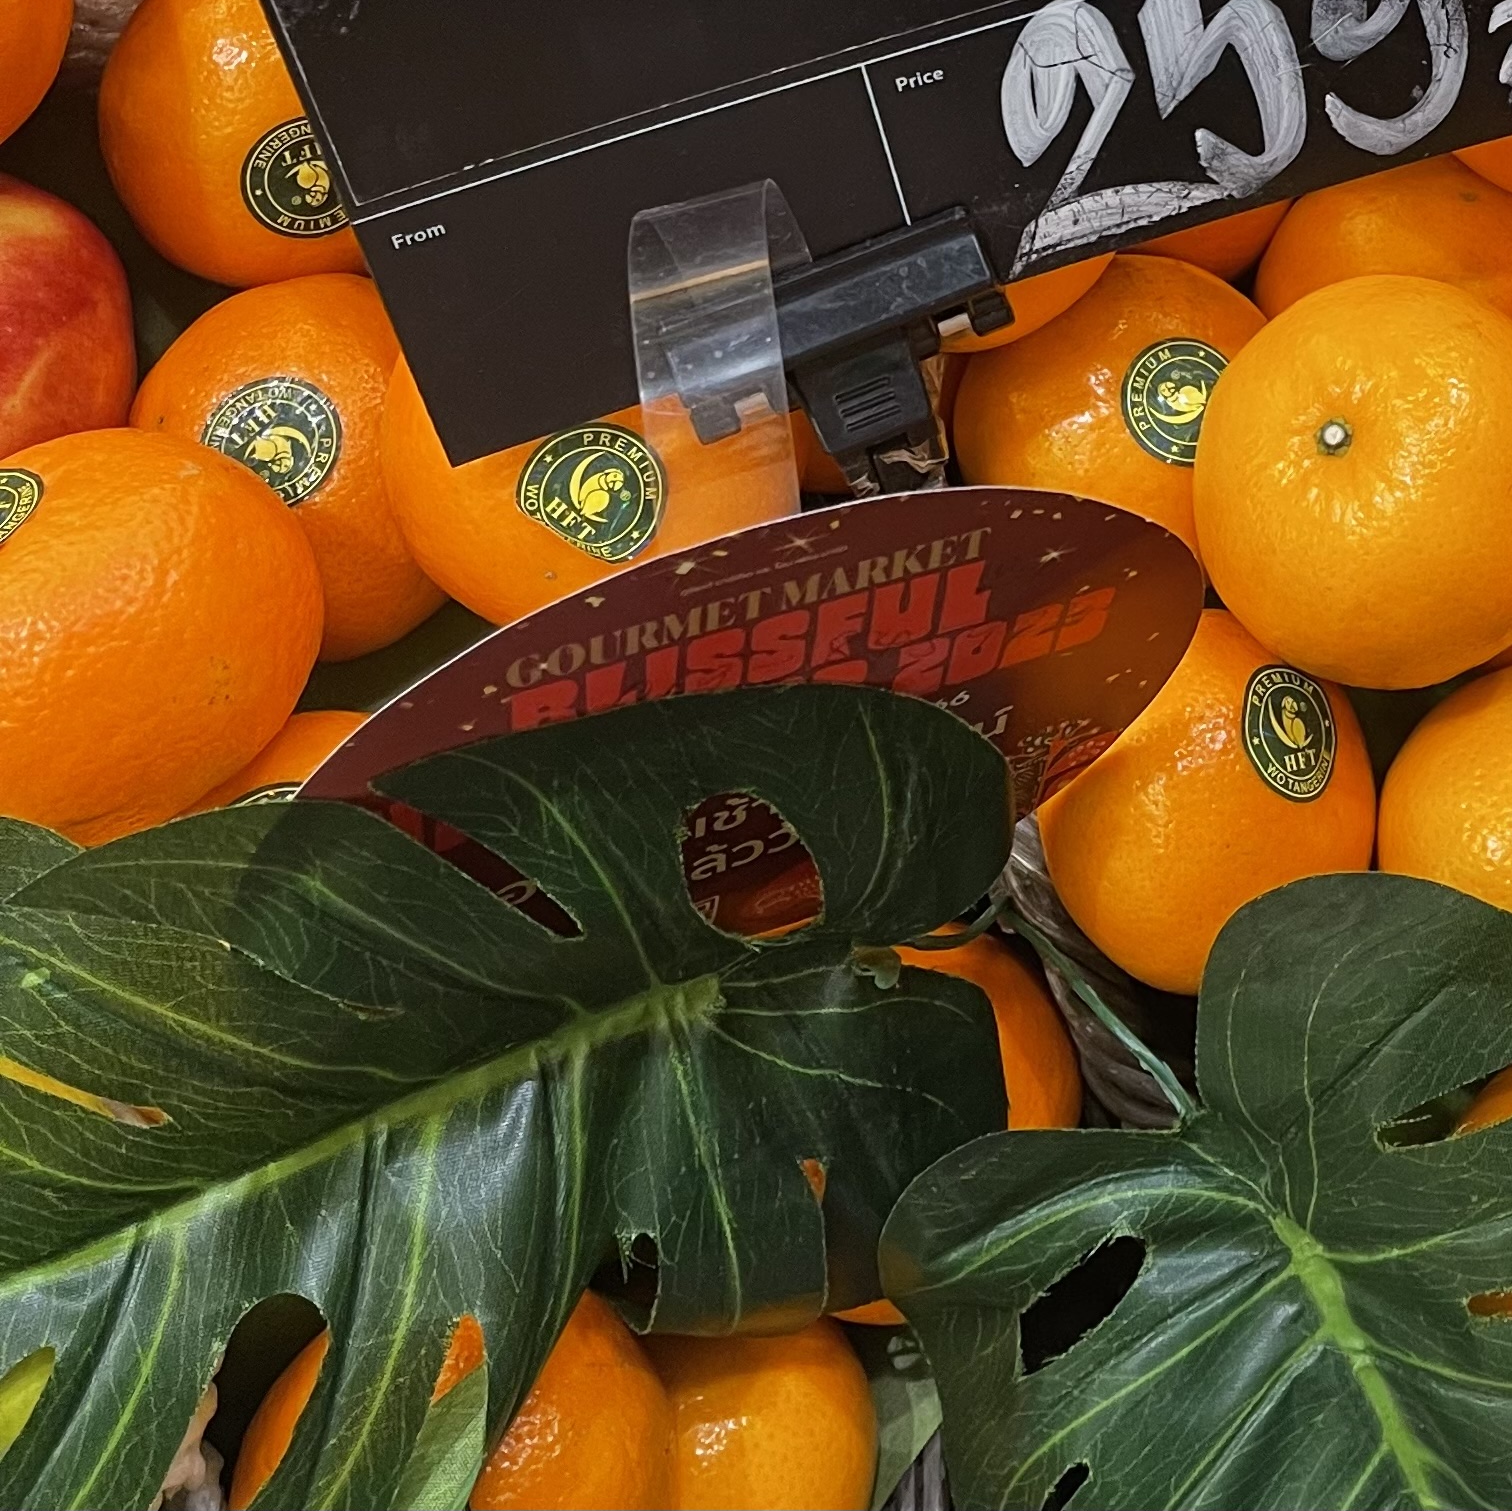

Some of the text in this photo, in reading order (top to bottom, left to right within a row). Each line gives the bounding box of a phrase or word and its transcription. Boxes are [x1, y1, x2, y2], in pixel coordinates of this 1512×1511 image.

[895, 67, 945, 92] Price
[276, 205, 348, 231] EMIUM
[391, 221, 446, 251] From
[1132, 349, 1172, 432] PREMIUM
[582, 432, 657, 500] PREMIUM
[545, 496, 596, 543] HFT
[505, 587, 772, 688] GOURMET
[779, 527, 992, 602] MARKET
[511, 560, 992, 731] BLISSFUL
[1251, 672, 1314, 705] PREMIUM
[1282, 748, 1317, 773] HFT
